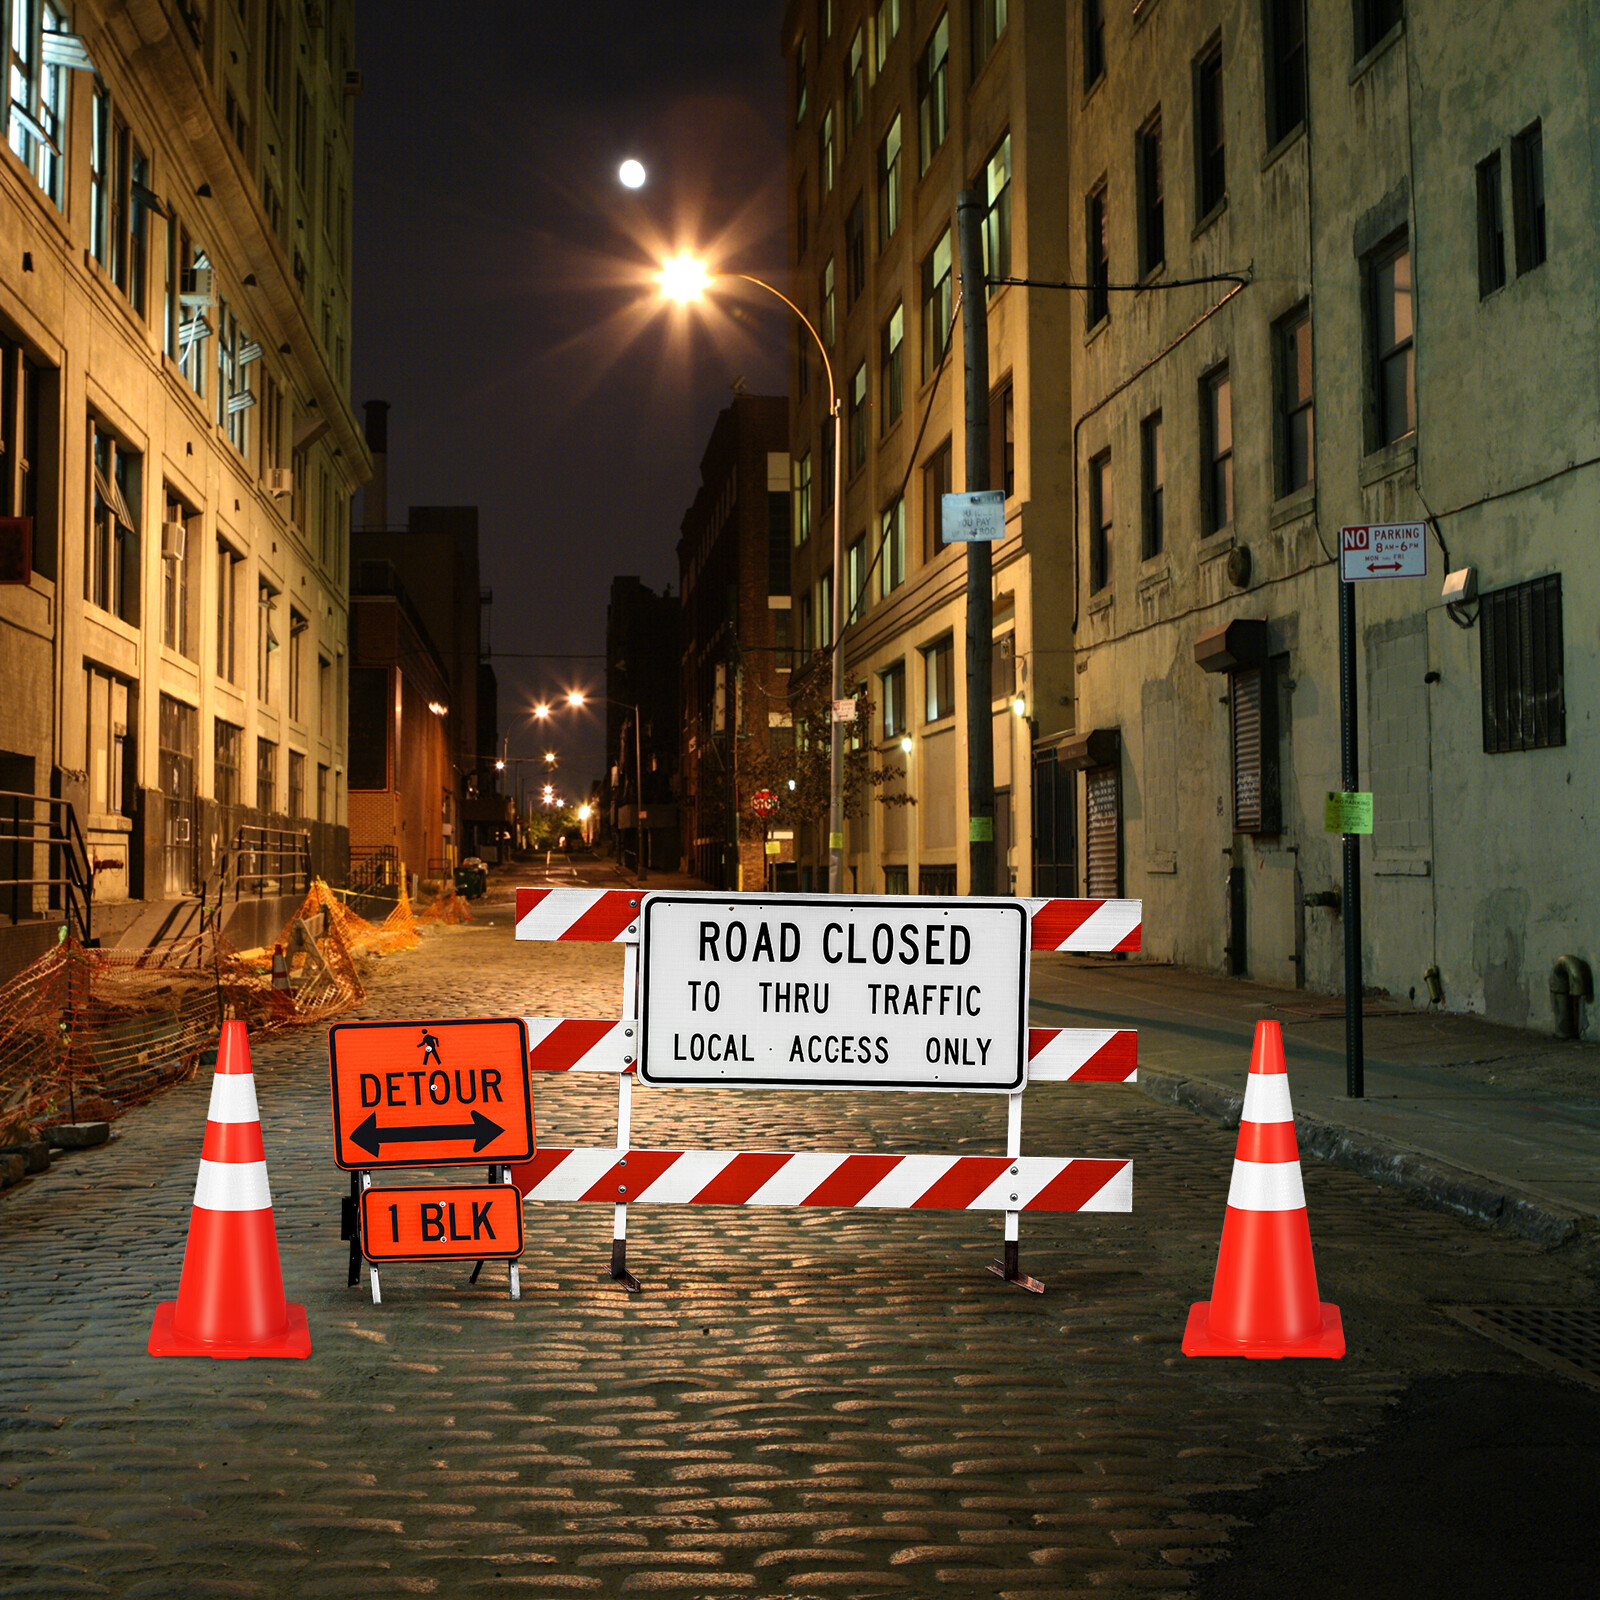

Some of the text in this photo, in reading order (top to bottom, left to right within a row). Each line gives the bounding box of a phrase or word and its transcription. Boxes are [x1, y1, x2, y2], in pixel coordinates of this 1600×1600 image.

[976, 517, 991, 526] PAY
[1344, 527, 1420, 549] NO PARKING
[699, 920, 971, 966] ROAD CLOSED
[687, 980, 982, 1017] TO THRU TRAFFIC
[674, 1033, 993, 1066] LOCAL ACCESS ONLY
[359, 1068, 504, 1108] DETOUR
[388, 1201, 497, 1243] 1 BLK
